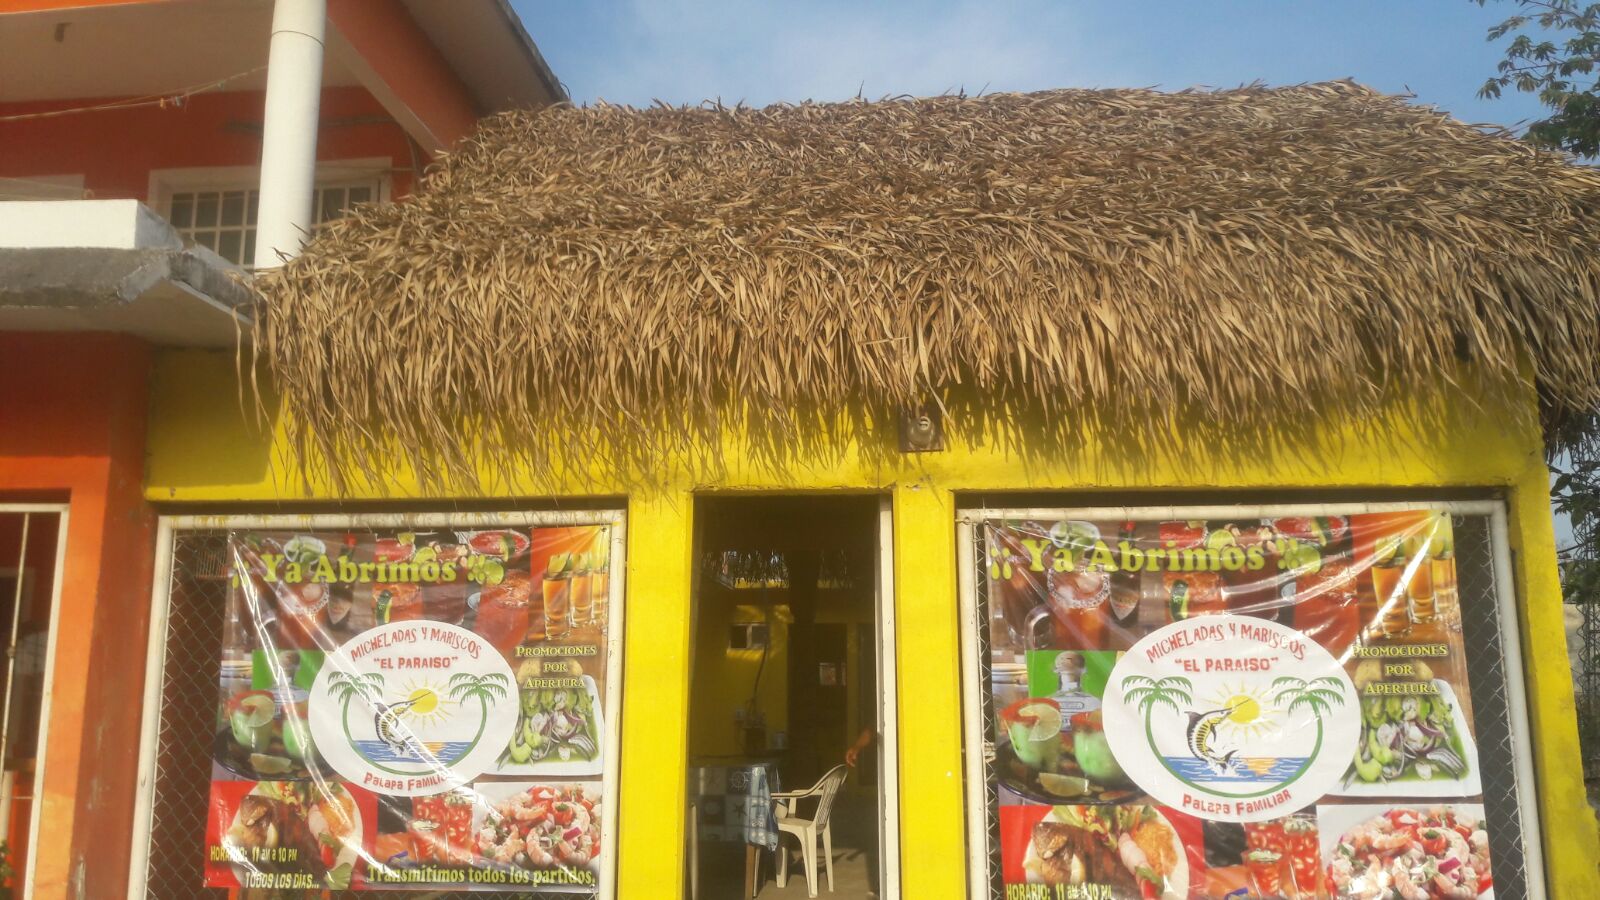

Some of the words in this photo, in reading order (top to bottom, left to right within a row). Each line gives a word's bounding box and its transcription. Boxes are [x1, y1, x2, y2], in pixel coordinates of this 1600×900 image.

[1021, 539, 1075, 572] Ya
[1087, 539, 1265, 572] Abrimos
[260, 553, 303, 583] Ya
[311, 554, 457, 583] Abrimos
[350, 627, 417, 662] MICHELADAS
[430, 628, 482, 659] MARISCOS
[515, 644, 598, 657] PROMOCIONES
[1146, 623, 1225, 663] MICHELADAS
[1241, 624, 1306, 660] MARISCOS
[1352, 643, 1450, 658] PROMOCIONES
[543, 662, 569, 673] POR
[1384, 663, 1416, 676] POR
[524, 676, 587, 689] APERTURA
[1363, 681, 1441, 695] APERTURA
[246, 872, 274, 888] TODOS
[274, 873, 292, 888] LOS
[367, 863, 465, 882] Transmitimos
[467, 865, 506, 883] todos
[509, 865, 530, 883] los
